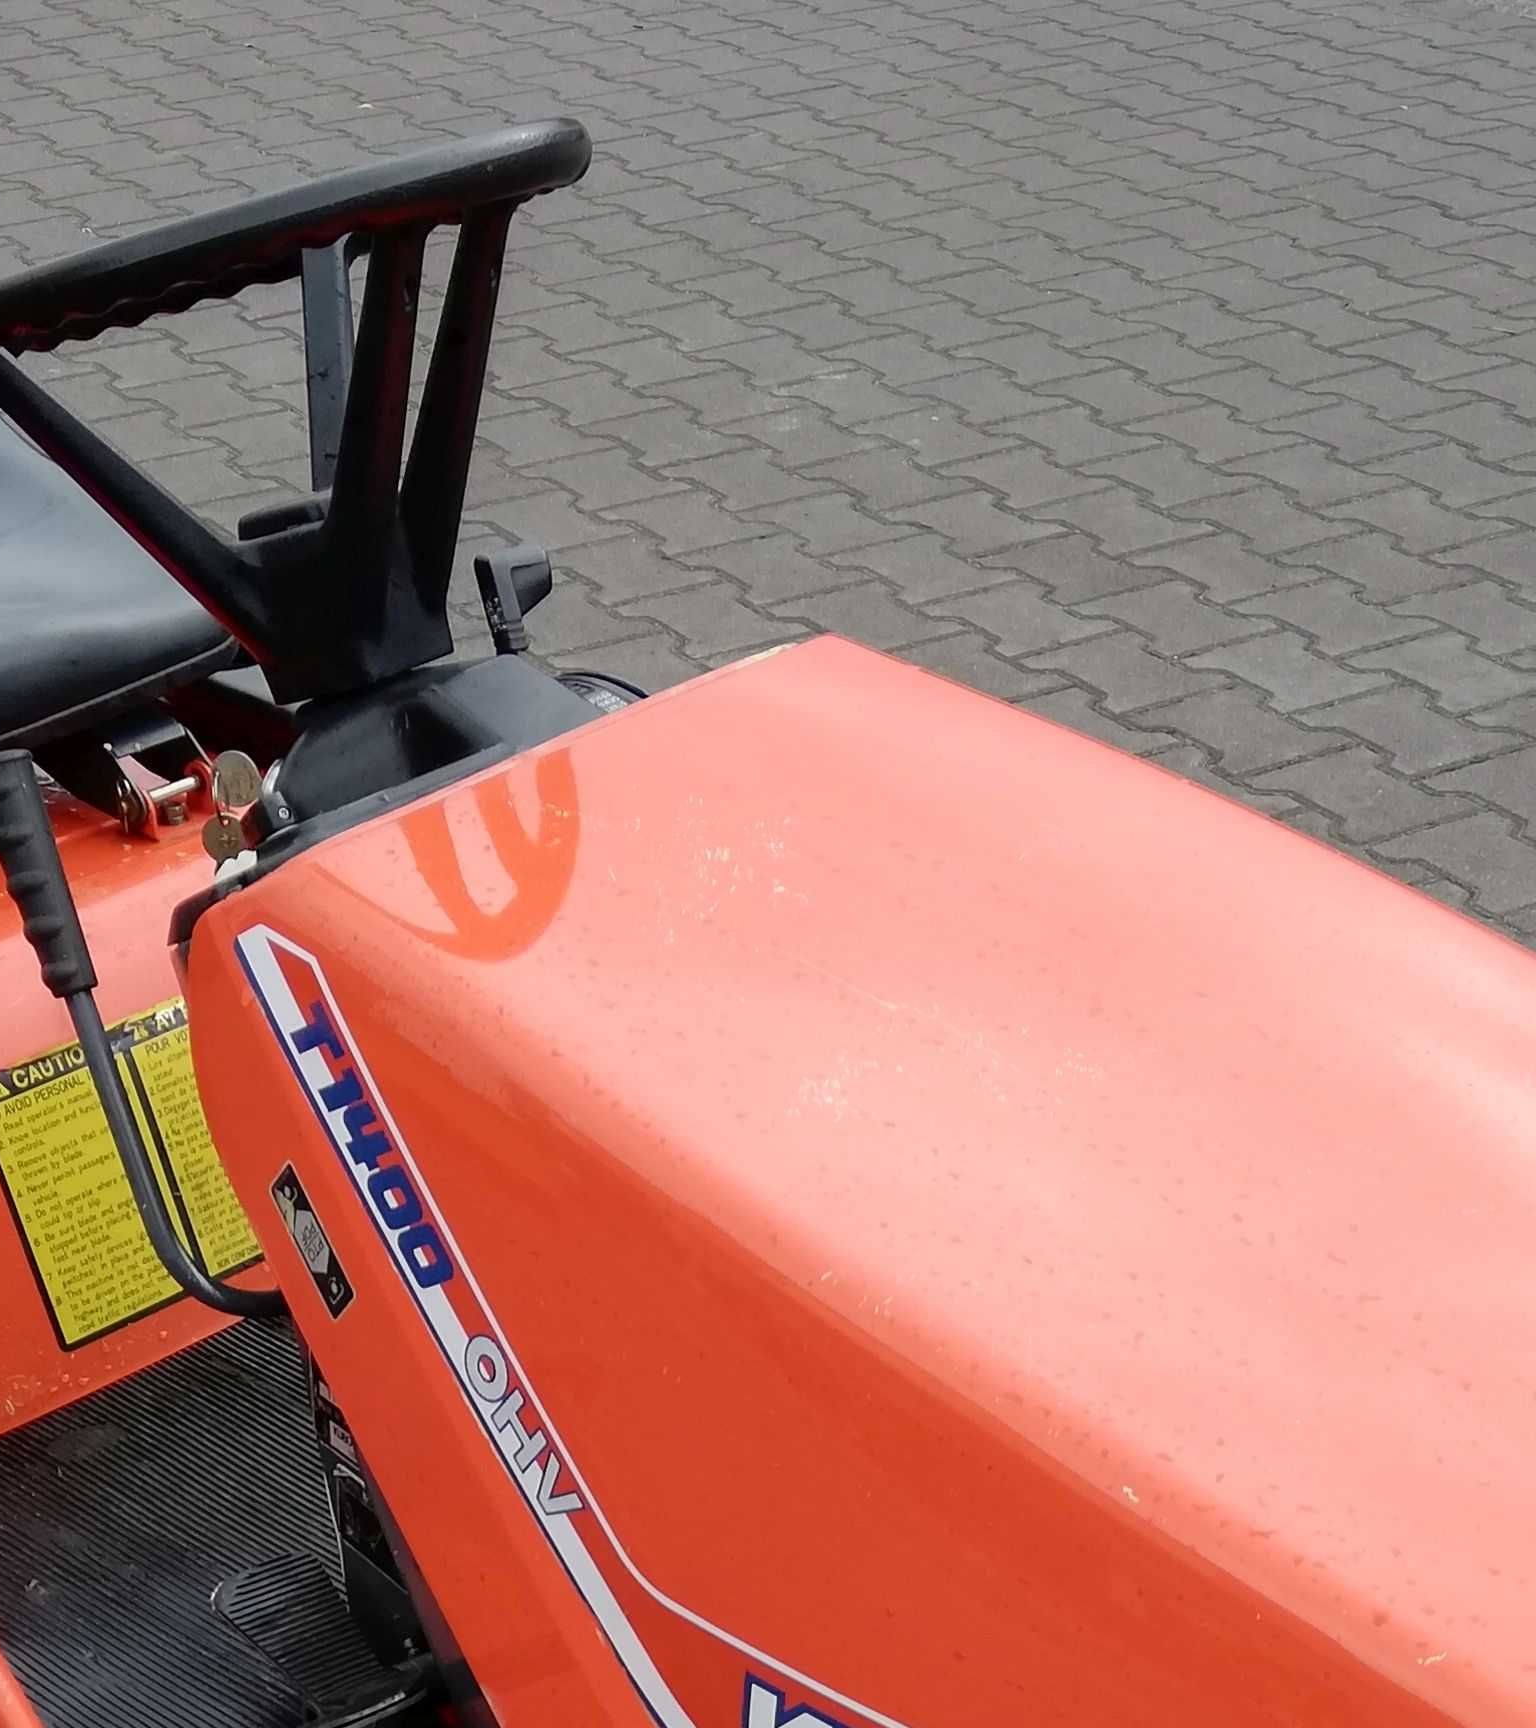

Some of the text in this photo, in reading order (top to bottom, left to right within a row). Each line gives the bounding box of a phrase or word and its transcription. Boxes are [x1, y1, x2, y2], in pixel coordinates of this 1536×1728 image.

[145, 1038, 170, 1056] POUR
[173, 1030, 187, 1043] VO
[12, 1047, 85, 1088] CAUTIO
[4, 1096, 32, 1115] AVOID
[34, 1076, 84, 1103] PERSONAL
[3, 1117, 23, 1132] Read
[8, 1133, 29, 1144] Know
[31, 1119, 60, 1135] location
[64, 1110, 77, 1122] and
[17, 1153, 46, 1169] Remove
[50, 1140, 78, 1156] objects
[81, 1131, 96, 1141] that
[290, 1001, 454, 1289] T1400
[22, 1166, 48, 1181] thrown
[50, 1161, 60, 1169] by
[26, 1180, 48, 1194] Never
[79, 1152, 115, 1174] passengers
[35, 1209, 46, 1219] Do
[50, 1201, 63, 1212] not
[66, 1189, 92, 1206] operate
[97, 1178, 117, 1191] where
[40, 1216, 60, 1229] could
[63, 1211, 73, 1219] tip
[44, 1233, 55, 1242] Be
[59, 1224, 75, 1236] sure
[78, 1215, 96, 1227] blade
[101, 1205, 114, 1217] and
[49, 1211, 131, 1253] stopped before placing
[53, 1251, 68, 1263] feet
[72, 1244, 87, 1255] near
[57, 1265, 76, 1276] Keep
[80, 1253, 102, 1266] safety
[106, 1238, 133, 1254] devices
[110, 1253, 129, 1268] place
[132, 1244, 145, 1255] and
[65, 1288, 82, 1298] This
[86, 1274, 114, 1291] machine
[127, 1261, 139, 1271] not
[95, 1287, 115, 1300] driven
[132, 1273, 144, 1281] the
[74, 1306, 103, 1321] highway
[107, 1296, 119, 1307] and
[123, 1288, 139, 1299] does
[142, 1279, 154, 1290] not
[79, 1320, 95, 1333] road
[98, 1310, 120, 1324] traffic
[463, 1333, 586, 1516] OHV
